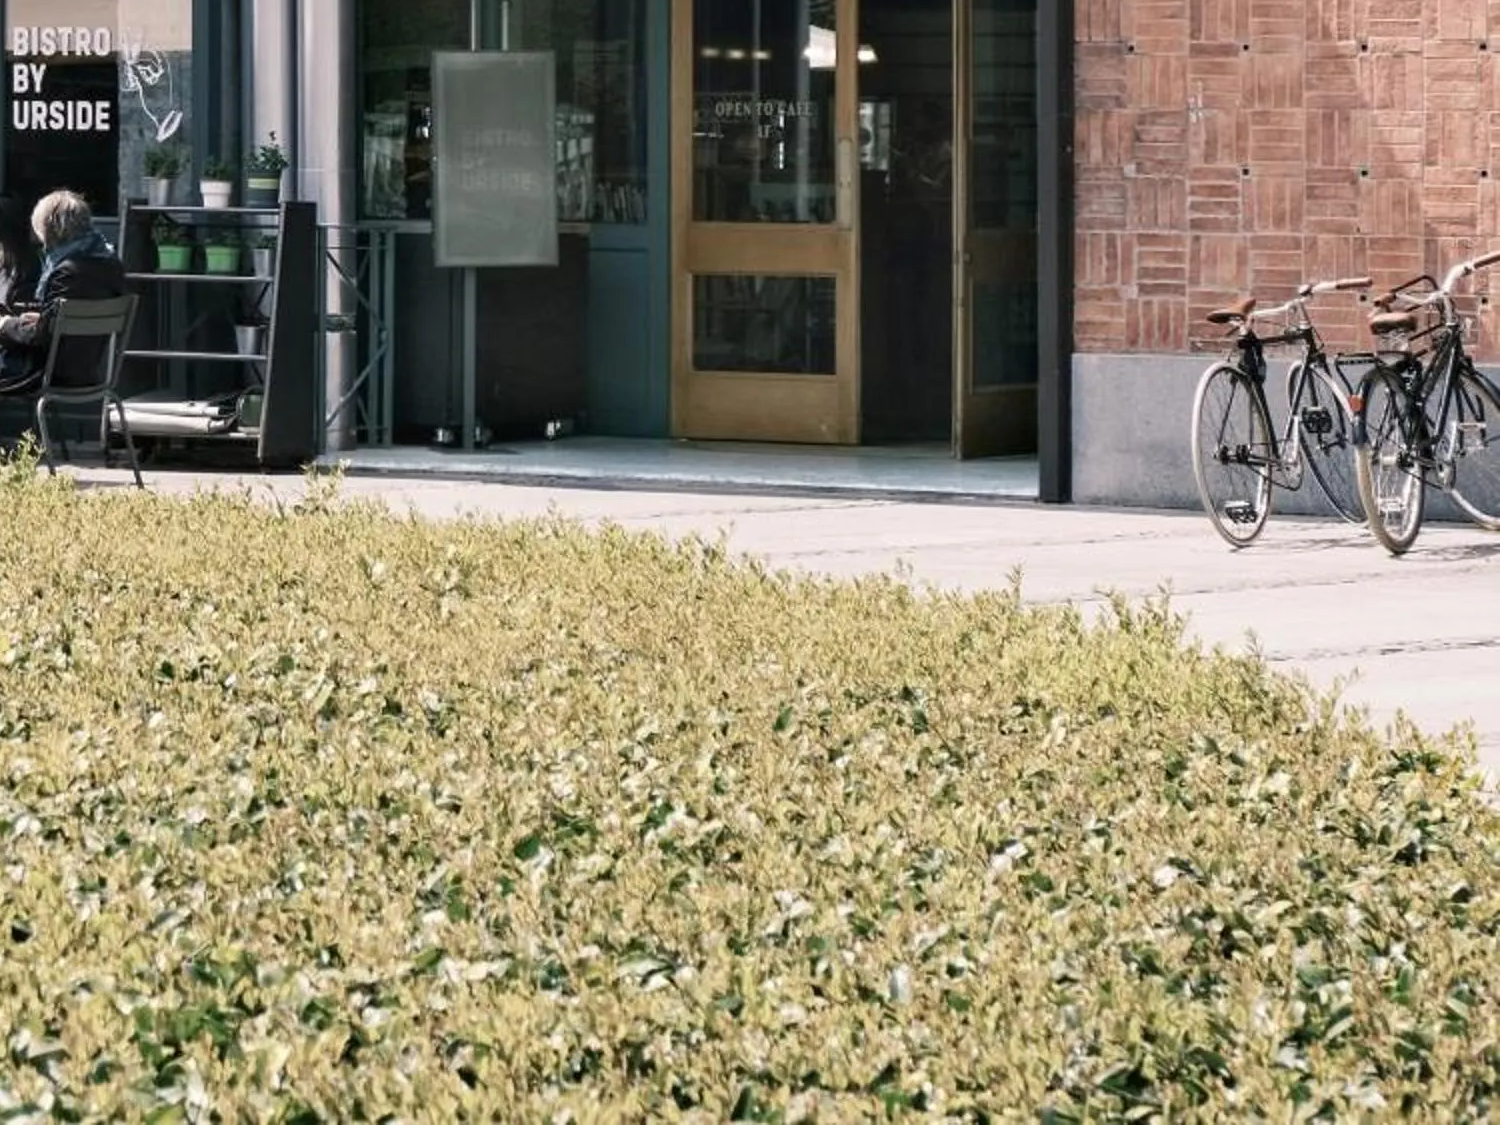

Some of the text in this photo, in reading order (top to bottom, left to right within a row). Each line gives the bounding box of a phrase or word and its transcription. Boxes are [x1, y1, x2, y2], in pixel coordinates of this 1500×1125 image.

[12, 26, 112, 57] BISTRO
[12, 63, 47, 93] BY
[12, 100, 111, 130] URSIDE
[715, 101, 751, 117] OPEN
[755, 101, 774, 116] TO
